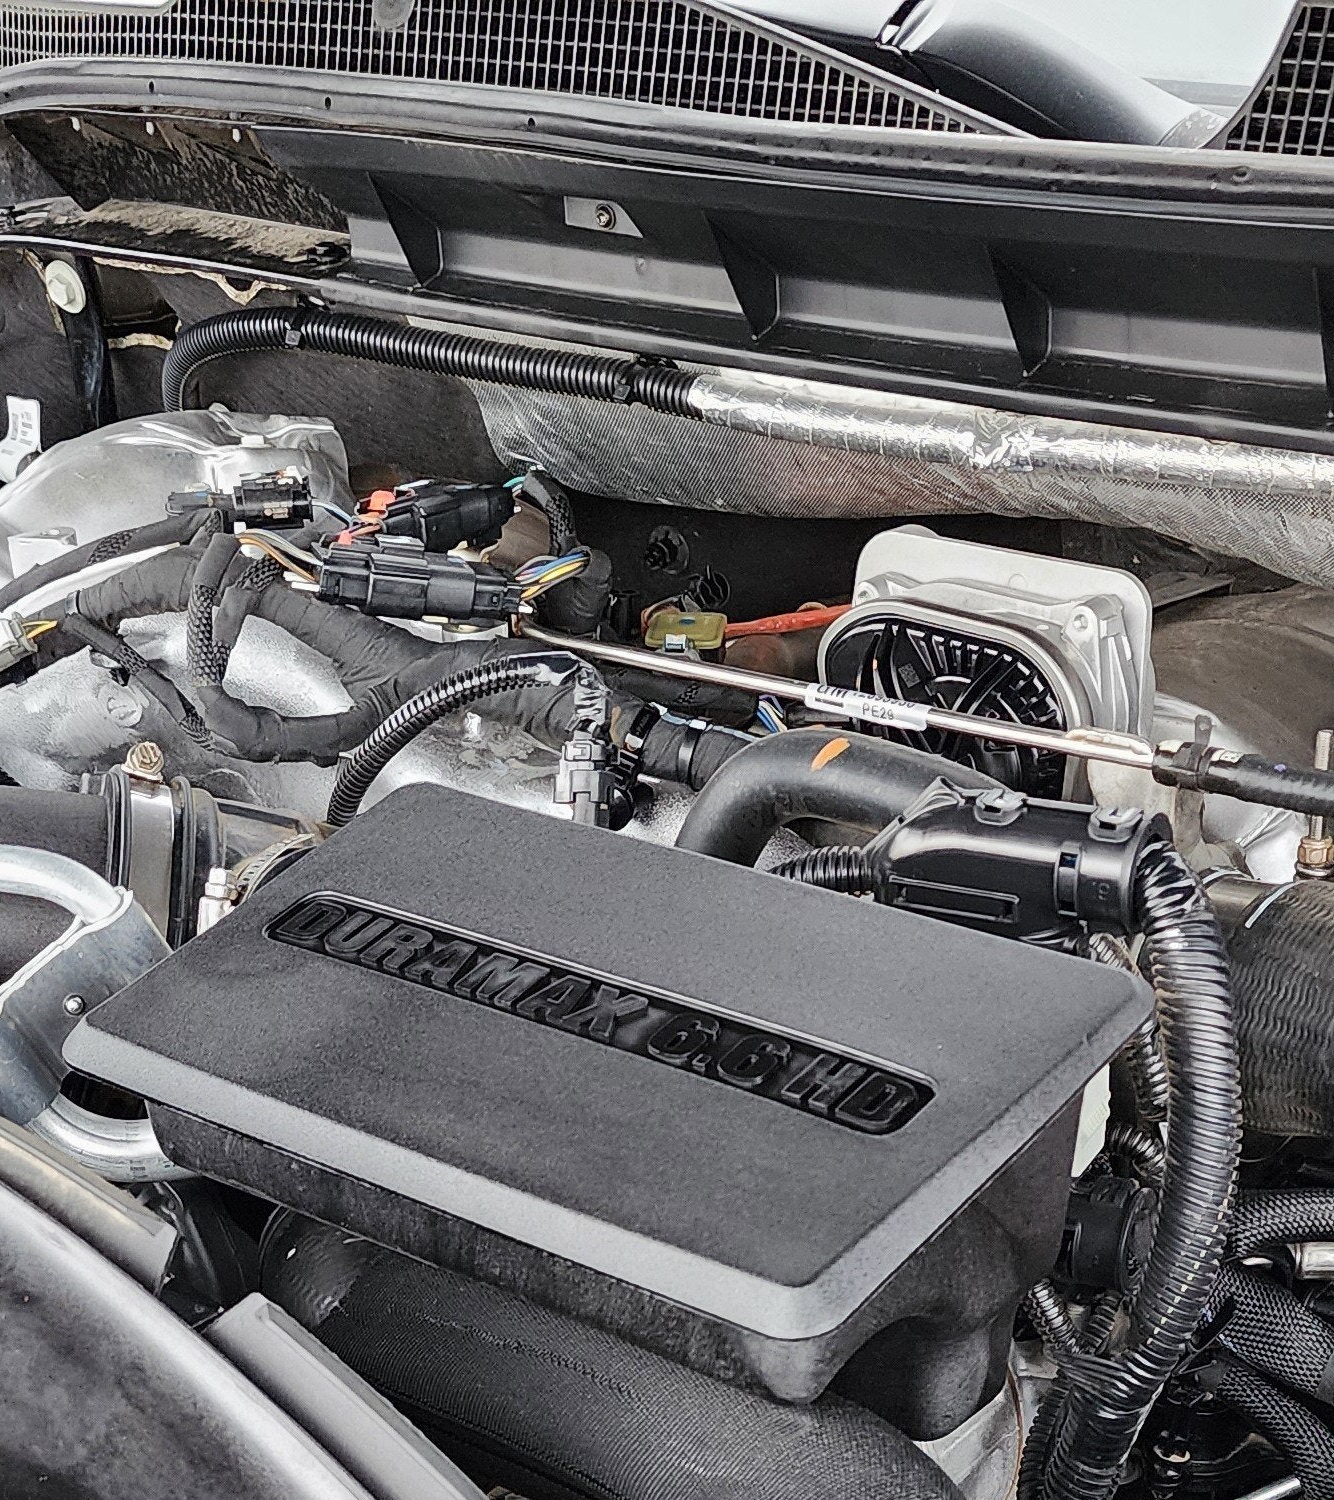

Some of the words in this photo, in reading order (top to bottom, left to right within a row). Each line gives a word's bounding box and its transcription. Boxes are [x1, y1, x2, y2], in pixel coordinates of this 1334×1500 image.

[862, 702, 895, 720] PE29
[276, 901, 649, 1043] DURAMAX
[647, 1012, 791, 1087] 6.6
[780, 1053, 920, 1131] HD
